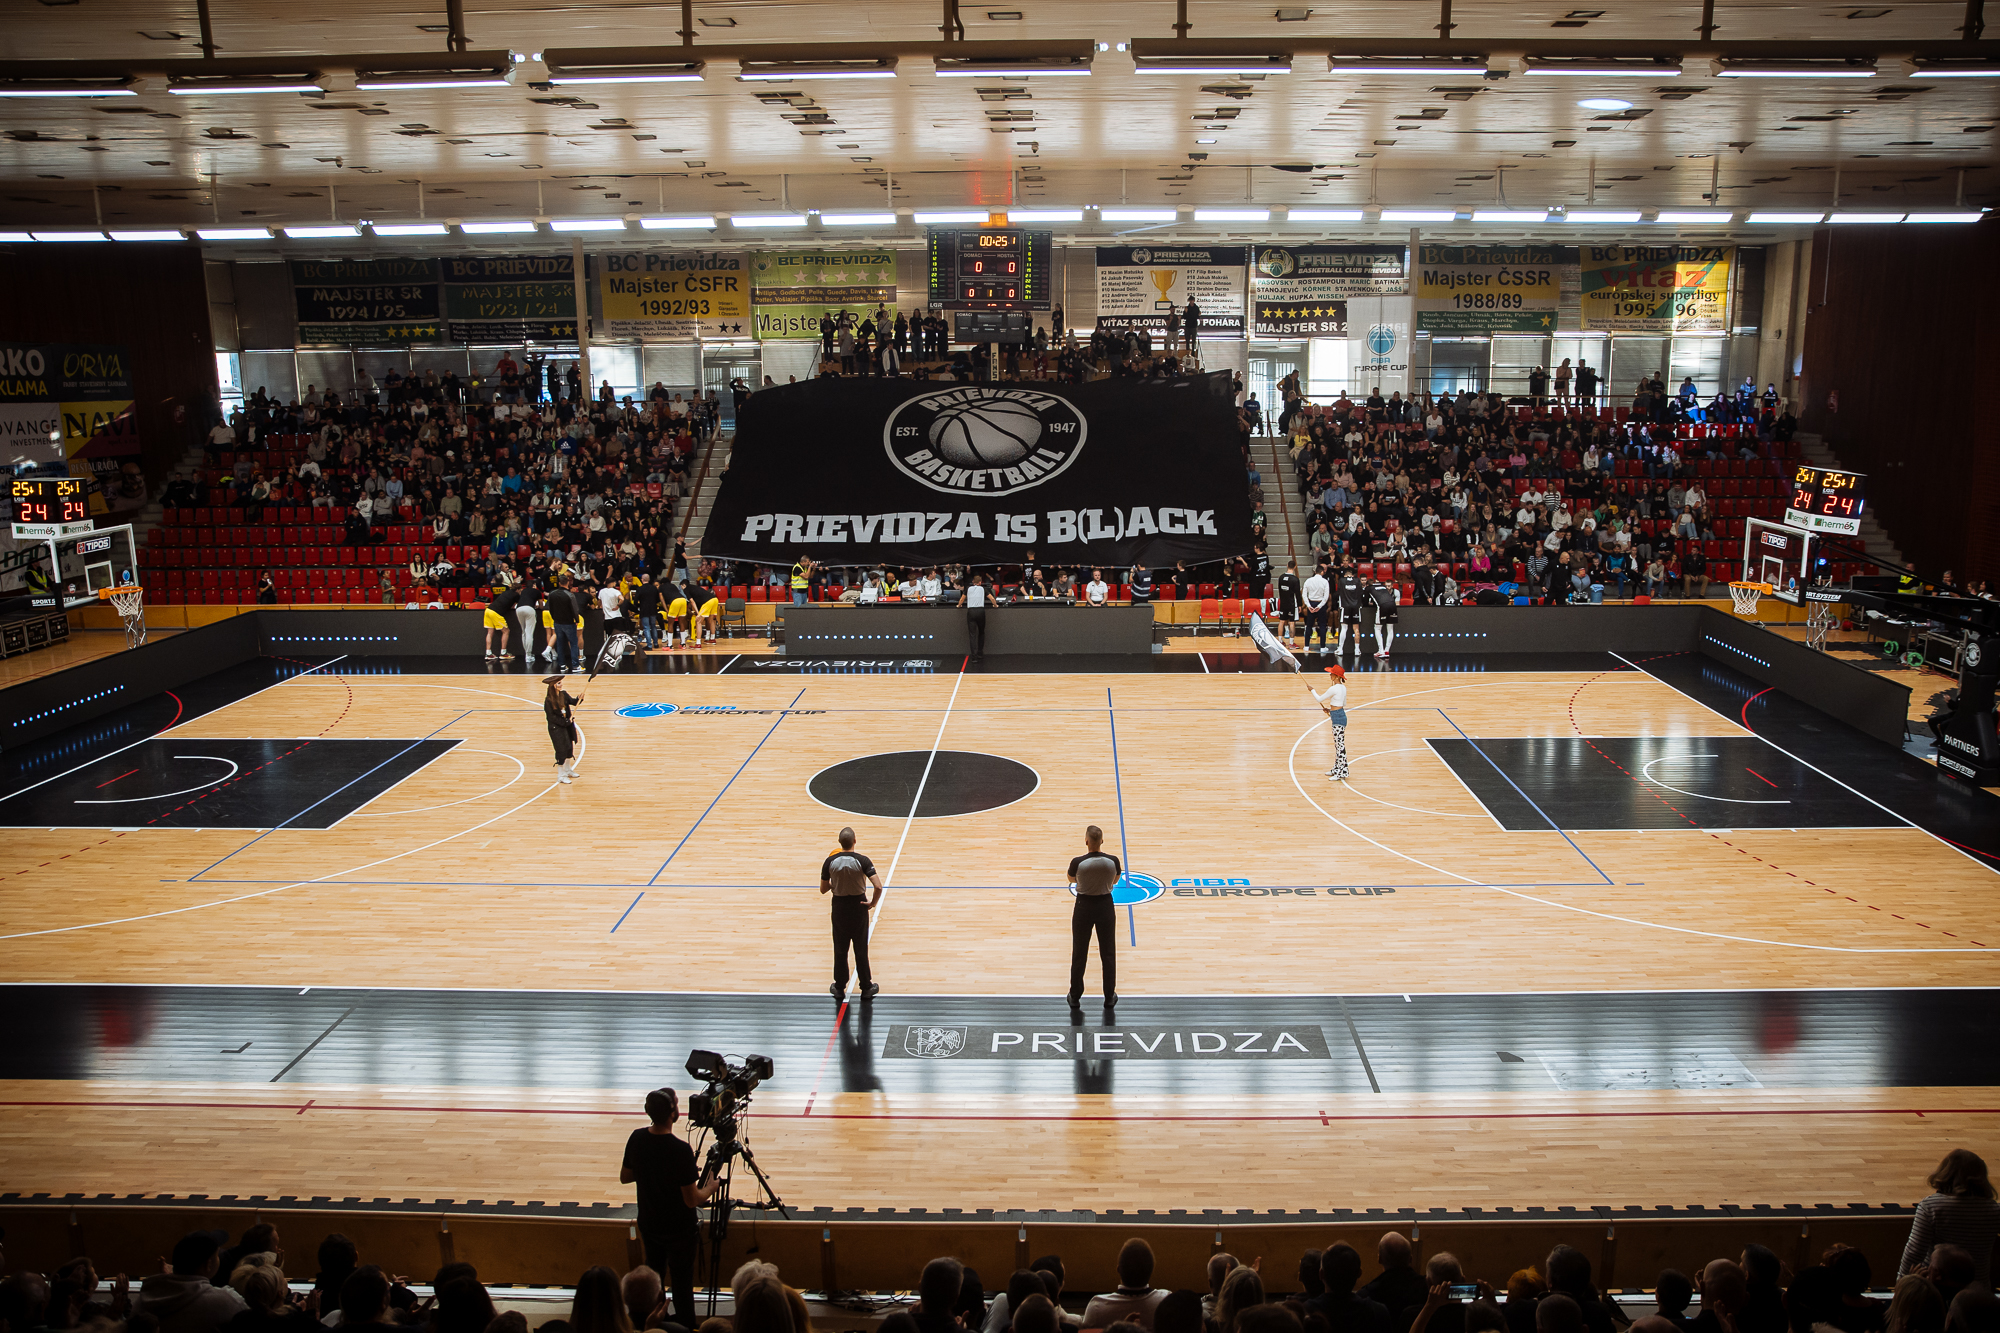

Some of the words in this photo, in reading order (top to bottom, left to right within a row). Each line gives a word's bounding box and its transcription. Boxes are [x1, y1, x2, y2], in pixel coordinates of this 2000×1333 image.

[777, 256, 799, 266] BC
[803, 255, 892, 266] PRIEVIDZA
[1299, 254, 1401, 267] PRIEVIDZA
[1424, 248, 1454, 264] BC
[1462, 248, 1553, 264] Prievidza
[1590, 247, 1618, 261] BC
[1624, 247, 1724, 261] PRIEVIDZA
[303, 264, 328, 278] BC
[334, 261, 429, 277] PRIEVIDZA
[452, 261, 479, 275] BC
[607, 254, 638, 272] BC
[645, 253, 740, 271] Prievidza
[975, 261, 983, 272] 0
[1008, 261, 1016, 273] 0
[1424, 270, 1492, 289] Majster
[1498, 266, 1551, 286] ČSSR
[1600, 263, 1708, 287] víťaz
[462, 287, 544, 299] MAJSTER
[551, 285, 573, 297] SR
[610, 278, 678, 297] Majster
[685, 273, 738, 292] ČSFR
[313, 287, 395, 301] MAJSTER
[400, 287, 423, 300] SR
[968, 288, 975, 298] 0
[1008, 288, 1015, 298] 0
[1590, 289, 1655, 302] európskej
[1660, 289, 1719, 302] superligy
[640, 299, 710, 316] 1992/93
[1453, 293, 1522, 309] 1988/89
[327, 305, 369, 319] 1994
[383, 304, 406, 318] 95
[1613, 303, 1656, 316] 1995
[1676, 303, 1696, 316] 96
[1101, 318, 1129, 327] VÍŤAZ
[1203, 318, 1241, 327] POHÁRA
[1256, 322, 1317, 333] MAJSTER
[1321, 322, 1338, 332] SR
[63, 353, 123, 378] ORVA
[917, 387, 1060, 412] PRIEVIDZA
[63, 412, 137, 439] NAVI
[895, 425, 920, 438] EST.
[1048, 422, 1077, 435] 1947
[903, 447, 1066, 490] BASKETBALL
[1794, 490, 1812, 509] 24
[1823, 495, 1854, 515] 24
[21, 503, 47, 521] 24
[64, 502, 84, 520] 24
[740, 511, 984, 545] PRIEVIDZA
[994, 513, 1039, 543] IS
[1047, 506, 1218, 544] B(L)ACK
[86, 538, 109, 551] TIPOS
[1768, 535, 1785, 547] TIPOS
[1944, 734, 1980, 757] PARTNERS
[1171, 878, 1251, 887] FIBA
[1173, 887, 1317, 897] EUROPE
[1326, 887, 1397, 896] CUP
[990, 1032, 1311, 1054] PRIEVIDZA
